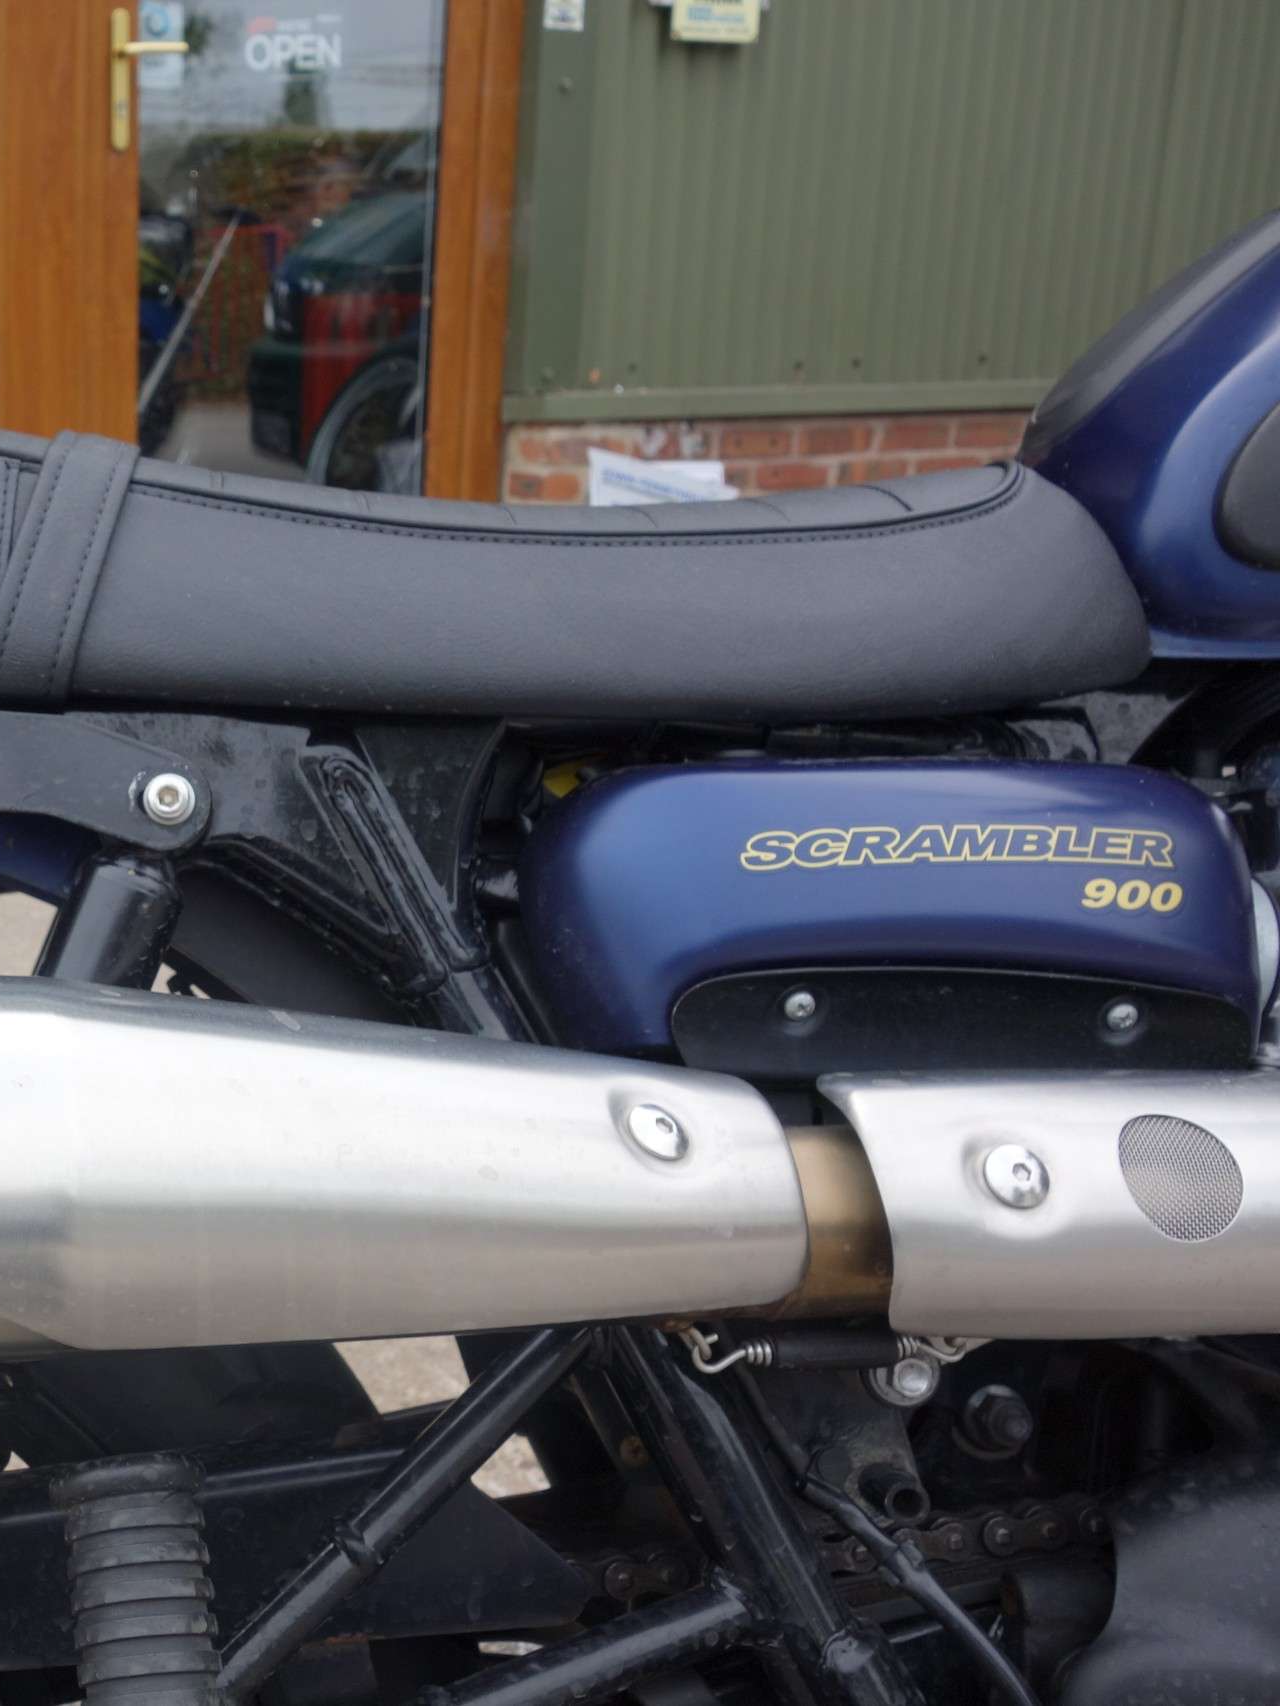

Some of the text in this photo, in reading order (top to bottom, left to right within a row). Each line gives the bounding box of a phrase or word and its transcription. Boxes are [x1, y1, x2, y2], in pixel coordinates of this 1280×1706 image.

[245, 33, 342, 71] OPEN
[740, 824, 1175, 872] SCRAMBLER
[1081, 877, 1184, 913] 900
